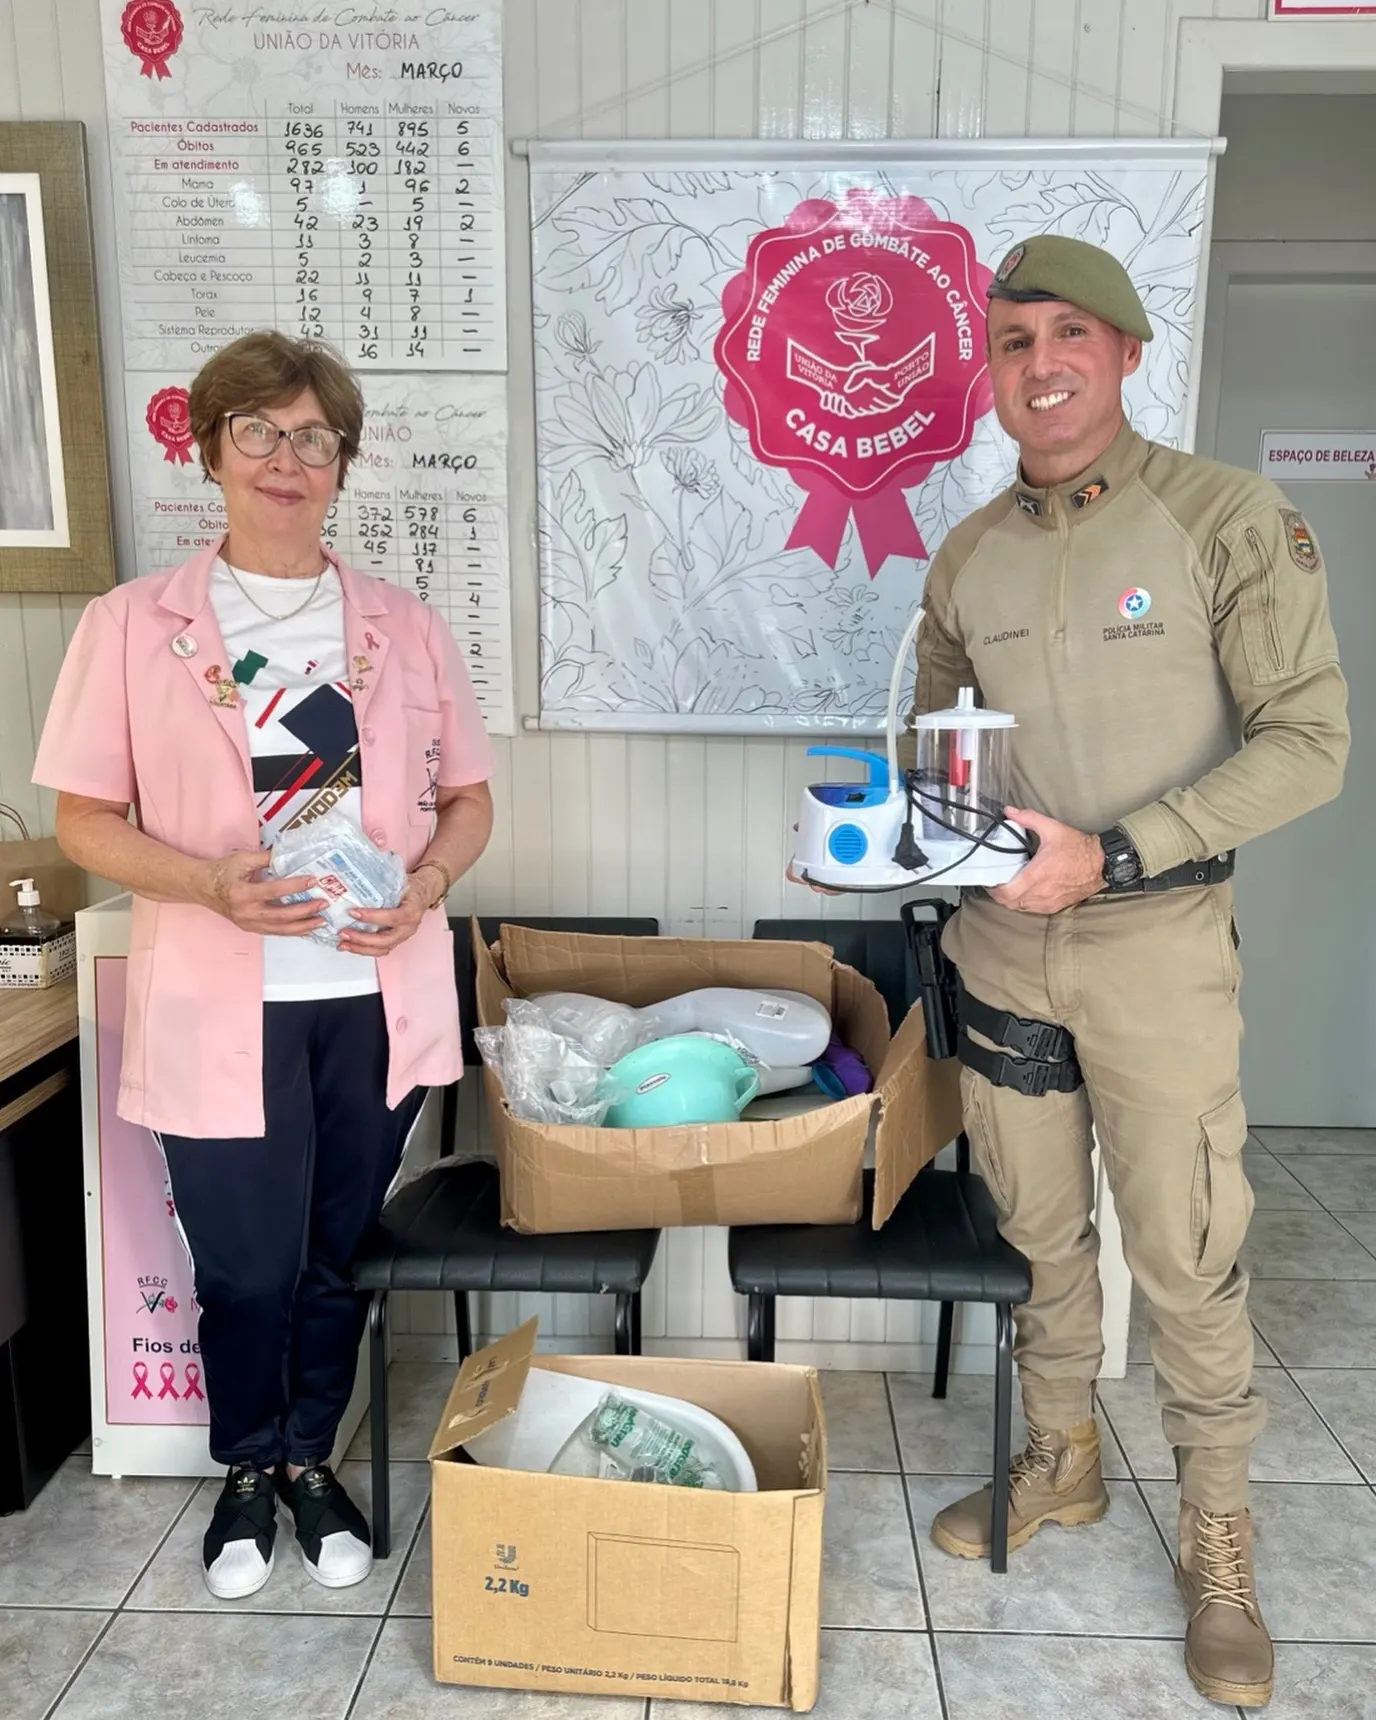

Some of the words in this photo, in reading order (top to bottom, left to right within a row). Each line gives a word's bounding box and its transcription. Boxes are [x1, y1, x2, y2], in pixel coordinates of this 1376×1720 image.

[253, 30, 312, 50] UNIÃO
[320, 33, 342, 50] DA
[348, 29, 420, 50] VITÓRIA
[346, 62, 383, 80] Mês:
[400, 62, 463, 84] MARÇO
[288, 103, 314, 115] Total
[340, 103, 380, 115] Homens
[388, 103, 434, 115] Mulheres
[448, 103, 480, 115] Novos
[130, 121, 183, 133] Pacientes
[186, 121, 259, 133] Cadastrados
[284, 122, 324, 139] 1636
[347, 121, 373, 136] 741
[398, 121, 429, 137] 895
[457, 121, 469, 135] 5
[177, 138, 215, 151] Óbitos
[285, 140, 323, 156] 965
[346, 142, 381, 157] 523
[396, 141, 429, 157] 442
[457, 141, 470, 156] 6
[154, 159, 168, 170] Em
[172, 159, 240, 170] atendimento
[287, 158, 325, 175] 282
[347, 160, 378, 175] 100
[394, 159, 426, 175] 182
[182, 178, 214, 190] Mama
[290, 178, 314, 194] 97
[404, 178, 431, 193] 96
[455, 178, 470, 194] 2
[162, 196, 188, 208] Colo
[190, 196, 205, 208] de
[208, 195, 236, 209] Útero
[296, 196, 309, 212] 5
[412, 197, 425, 212] 5
[176, 215, 225, 227] Abdômen
[294, 213, 319, 231] 42
[352, 214, 379, 231] 23
[403, 215, 423, 231] 19
[459, 214, 475, 231] 2
[182, 233, 220, 245] Linfoma
[358, 232, 372, 250] 3
[408, 233, 420, 249] 8
[298, 251, 309, 267] 5
[358, 252, 372, 267] 2
[409, 251, 423, 268] 3
[154, 269, 197, 283] Cabeça
[200, 273, 207, 281] e
[210, 269, 253, 283] Pescoço
[295, 269, 320, 285] 22
[296, 288, 319, 303] 16
[362, 288, 373, 303] 9
[408, 288, 420, 303] 7
[747, 315, 767, 361] REDE
[757, 245, 822, 314] FEMININA
[822, 235, 847, 255] DE
[849, 232, 931, 270] COMBATE
[926, 264, 951, 289] AO
[946, 288, 973, 361] CÂNCER
[194, 306, 216, 318] Pele
[298, 306, 322, 322] 12
[360, 306, 371, 320] 4
[410, 305, 422, 322] 8
[158, 324, 196, 335] Sistema
[358, 324, 379, 340] 31
[358, 343, 378, 359] 16
[406, 341, 425, 358] 14
[894, 351, 930, 381] PORTO
[897, 362, 930, 389] UNIÃO
[785, 408, 848, 459] CASA
[855, 410, 936, 459] BEBEL
[412, 452, 478, 474] MARÇO
[1268, 449, 1313, 465] ESPAÇO
[1315, 450, 1331, 462] DE
[1332, 449, 1376, 463] BELEZA
[354, 489, 391, 500] Homens
[400, 489, 443, 501] Mulheres
[456, 491, 487, 502] Novos
[154, 501, 205, 513] Pacientes
[357, 505, 395, 521] 372
[403, 505, 439, 521] 578
[463, 508, 477, 523] 6
[358, 523, 393, 538] 252
[408, 522, 439, 540] 284
[176, 535, 191, 546] Em
[364, 540, 387, 555] 45
[412, 542, 438, 557] 117
[415, 575, 429, 590] 5
[469, 592, 481, 607] 4
[1132, 622, 1164, 631] MILITAR
[982, 628, 1030, 646] CLAUDINEI
[1103, 631, 1127, 642] SANTA
[1128, 628, 1166, 640] CATARINA
[469, 643, 483, 656] 2
[132, 1337, 173, 1354] Fios
[179, 1338, 201, 1354] de
[484, 1575, 507, 1594] 2,2
[509, 1578, 530, 1598] Kg
[452, 1654, 486, 1666] CONTÉM
[493, 1660, 535, 1672] UNIDADES
[541, 1665, 562, 1674] PESO
[563, 1666, 603, 1678] UNITÁRIO
[635, 1673, 657, 1682] PESO
[659, 1671, 693, 1683] LÍQUIDO
[694, 1676, 720, 1685] TOTAL
